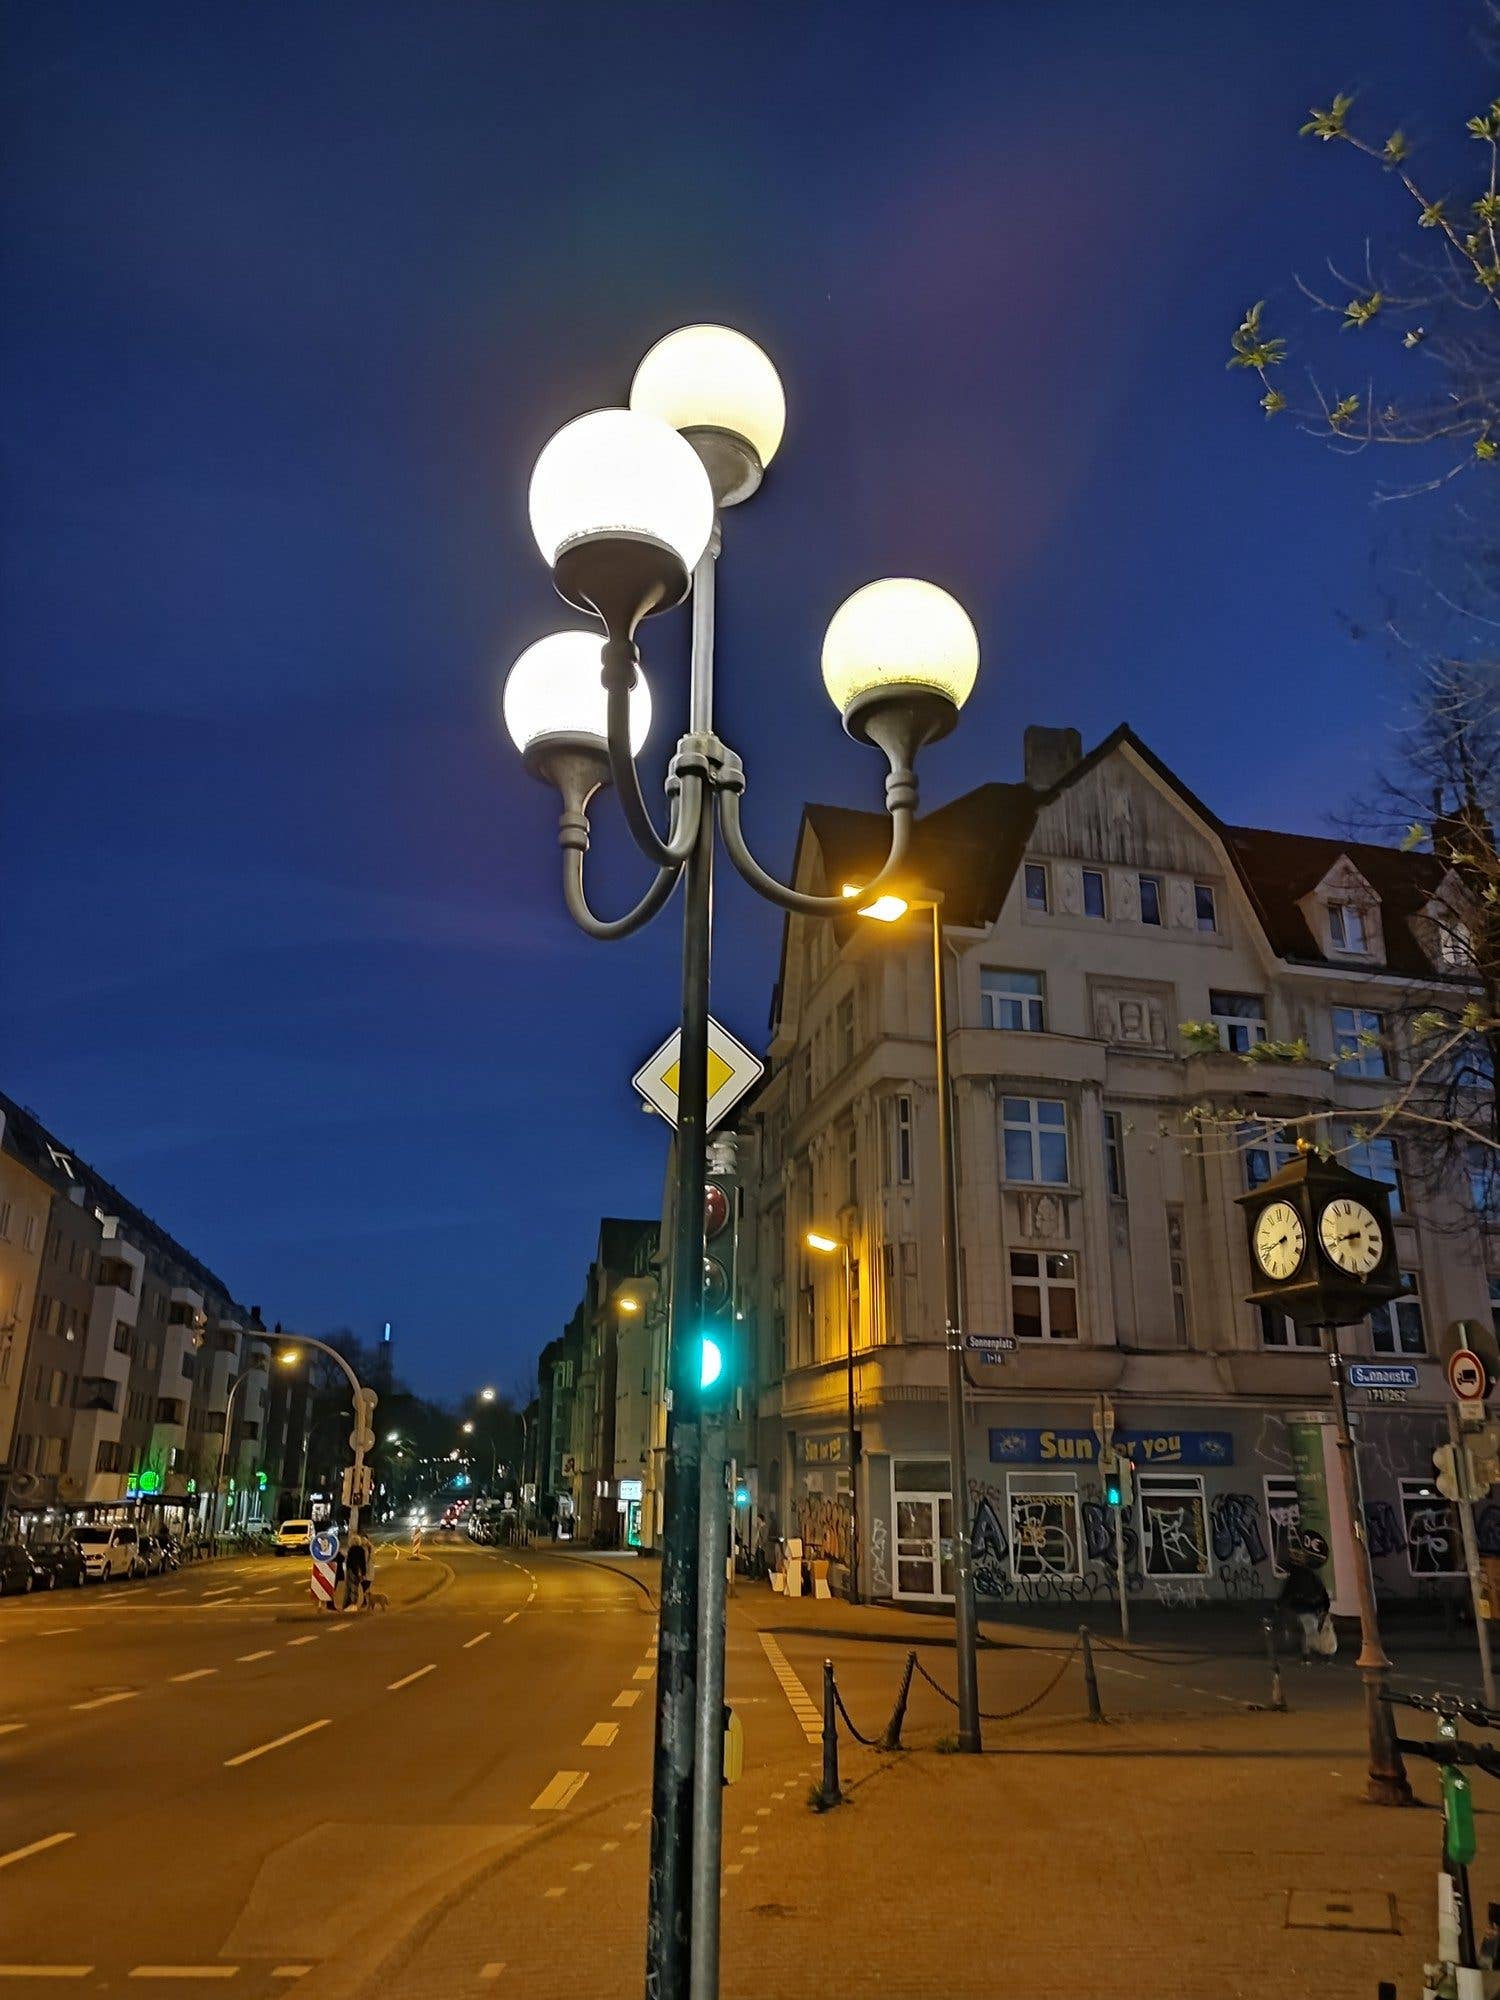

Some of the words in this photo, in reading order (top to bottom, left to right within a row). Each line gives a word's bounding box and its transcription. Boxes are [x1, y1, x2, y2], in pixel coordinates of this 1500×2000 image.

[969, 1336, 1013, 1351] Sonnenplatz
[1039, 1431, 1093, 1460] Sun
[1111, 1440, 1137, 1458] or
[1142, 1435, 1181, 1460] you
